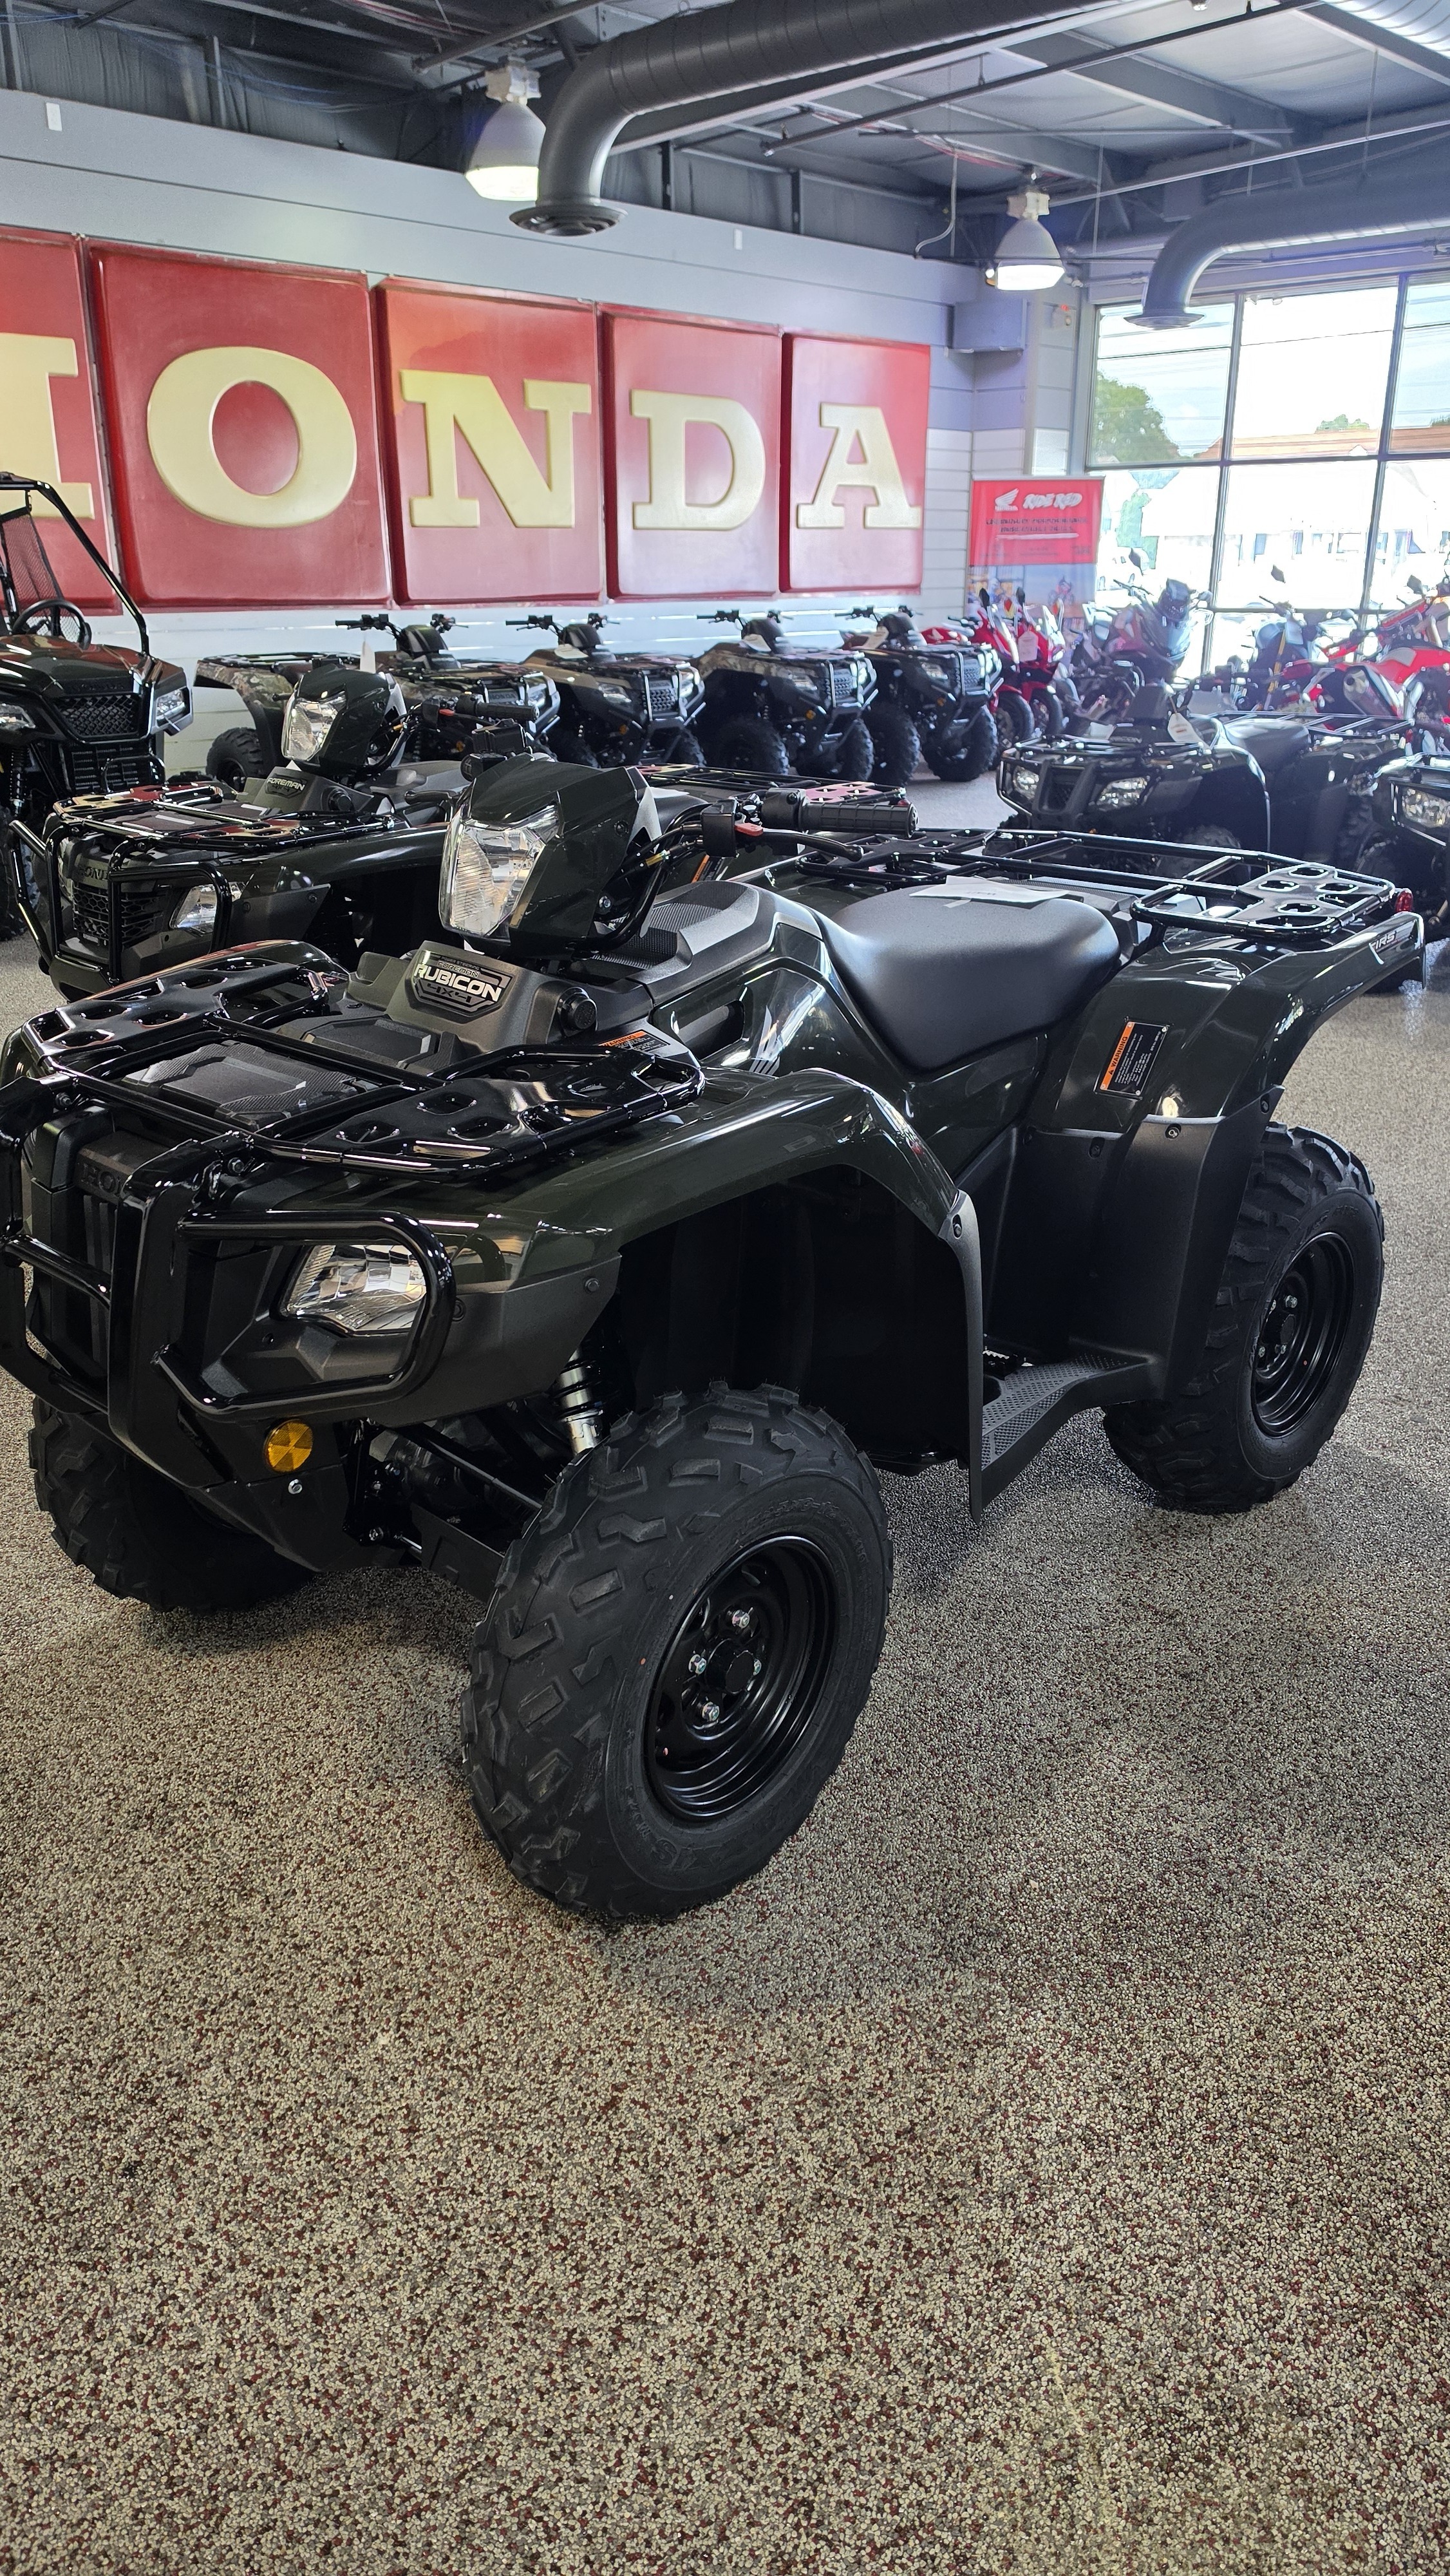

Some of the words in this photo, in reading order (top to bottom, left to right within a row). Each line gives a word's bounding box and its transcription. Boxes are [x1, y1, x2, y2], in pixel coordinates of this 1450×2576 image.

[267, 777, 306, 791] FOREMAN
[438, 961, 479, 978] FOREMAN
[413, 963, 502, 1002] RUBICON
[1111, 1036, 1128, 1068] WARNING
